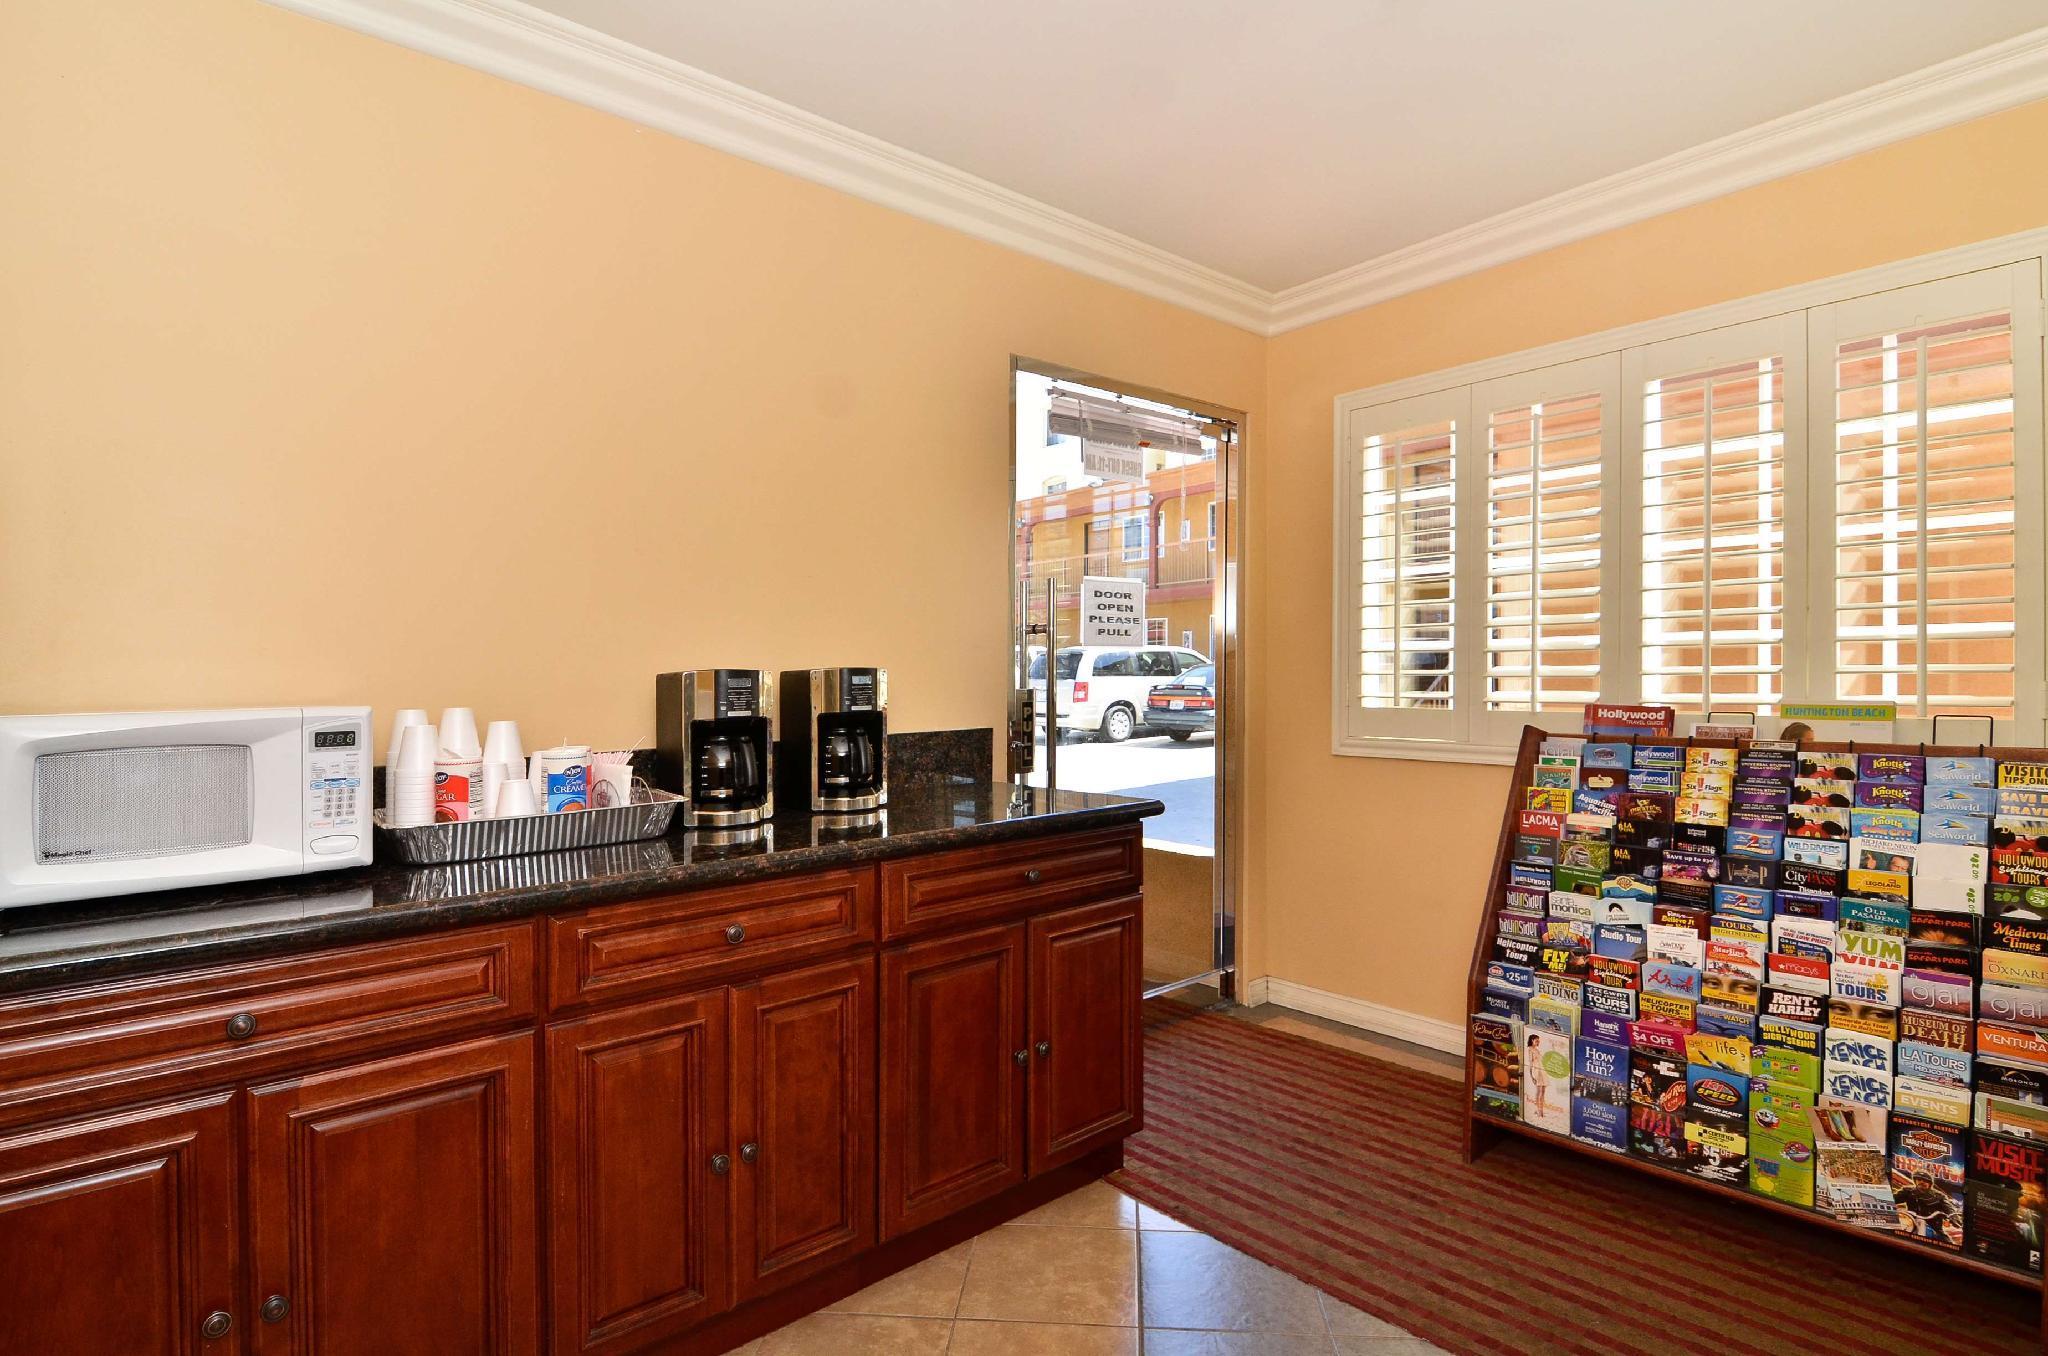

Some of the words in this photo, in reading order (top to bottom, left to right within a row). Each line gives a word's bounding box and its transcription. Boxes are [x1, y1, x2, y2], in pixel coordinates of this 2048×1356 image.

[1094, 590, 1132, 600] DOOR
[1097, 603, 1134, 613] OPEN
[1089, 615, 1140, 625] PLEASE
[1097, 628, 1132, 637] PULL
[1597, 708, 1665, 722] Hollywood
[1786, 707, 1849, 717] HUNTINGTON
[1852, 708, 1886, 718] BEACH
[1023, 706, 1032, 760] PULL
[1635, 750, 1675, 761] hollywood
[1710, 758, 1728, 767] Flags
[1629, 773, 1669, 785] hollywood
[1934, 772, 1982, 781] SeaWorld
[2004, 776, 2025, 785] TIPS
[553, 784, 586, 793] CREAME
[1686, 782, 1696, 790] Six
[1705, 783, 1722, 792] Flags
[436, 793, 456, 801] GAR
[1577, 793, 1616, 811] Aquarium
[2001, 791, 2037, 804] SAVE
[1588, 803, 1615, 818] Pacific
[1680, 808, 1691, 816] Six
[1699, 809, 1718, 818] Flags
[1930, 802, 1980, 812] SeaWorld
[1522, 814, 1558, 827] LACMA
[1927, 831, 1977, 841] SeaWorld
[1677, 842, 1716, 854] SHOPPING
[1788, 841, 1809, 850] WILD
[1810, 843, 1841, 854] RIVERS
[1866, 881, 1901, 889] LEGOLAND
[2013, 873, 2040, 885] TOURS
[1551, 903, 1591, 916] monica
[1864, 906, 1886, 916] OLD
[1851, 909, 1900, 924] PASADENA
[1720, 920, 1753, 931] TOURS
[1601, 928, 1623, 940] Studio
[1626, 931, 1642, 944] Tour
[1496, 937, 1538, 952] Helicopter
[1842, 934, 1903, 962] YUM
[2003, 935, 2041, 951] Times
[1506, 949, 1528, 962] Tours
[1542, 949, 1569, 962] FLY
[1943, 957, 1968, 965] PARK
[1548, 962, 1567, 971] ME!
[1593, 960, 1633, 975] HOLLYWOOD
[1785, 962, 1819, 976] macy's
[1506, 971, 1520, 981] $25
[1603, 976, 1623, 988] TOURS
[1538, 983, 1578, 1001] RIDING
[1836, 982, 1887, 1002] TOURS
[1911, 984, 1961, 1007] ojai
[1587, 993, 1629, 1009] TOURS
[1641, 996, 1690, 1010] HELICOPTER
[1772, 992, 1813, 1006] RENT
[1650, 1005, 1681, 1016] TOURS
[1768, 1004, 1821, 1017] HARLEY
[1991, 996, 2042, 1020] ojai
[1902, 1015, 1949, 1031] MUSEUM
[1952, 1024, 1967, 1034] OF
[1762, 1024, 1816, 1041] HOLLYWOOD
[1902, 1024, 1967, 1046] DEATH
[1650, 1035, 1675, 1046] OFF
[1762, 1032, 1816, 1049] SIGHTSEEING
[1983, 1033, 2047, 1052] VENTURA
[1585, 1046, 1615, 1063] How
[1716, 1041, 1737, 1055] life
[1827, 1041, 1887, 1060] VENICE
[1901, 1047, 1921, 1062] LA
[1922, 1051, 1967, 1071] TOURS
[1586, 1060, 1614, 1076] fun?
[1828, 1074, 1890, 1095] VENICE
[1697, 1088, 1739, 1102] SPEED
[1901, 1096, 1959, 1116] EVENTS
[1719, 1109, 1743, 1118] KART
[1707, 1130, 1735, 1142] CERTIFIED
[1703, 1144, 1721, 1166] $5
[1720, 1148, 1735, 1158] OFF
[1979, 1138, 2043, 1168] VISIT
